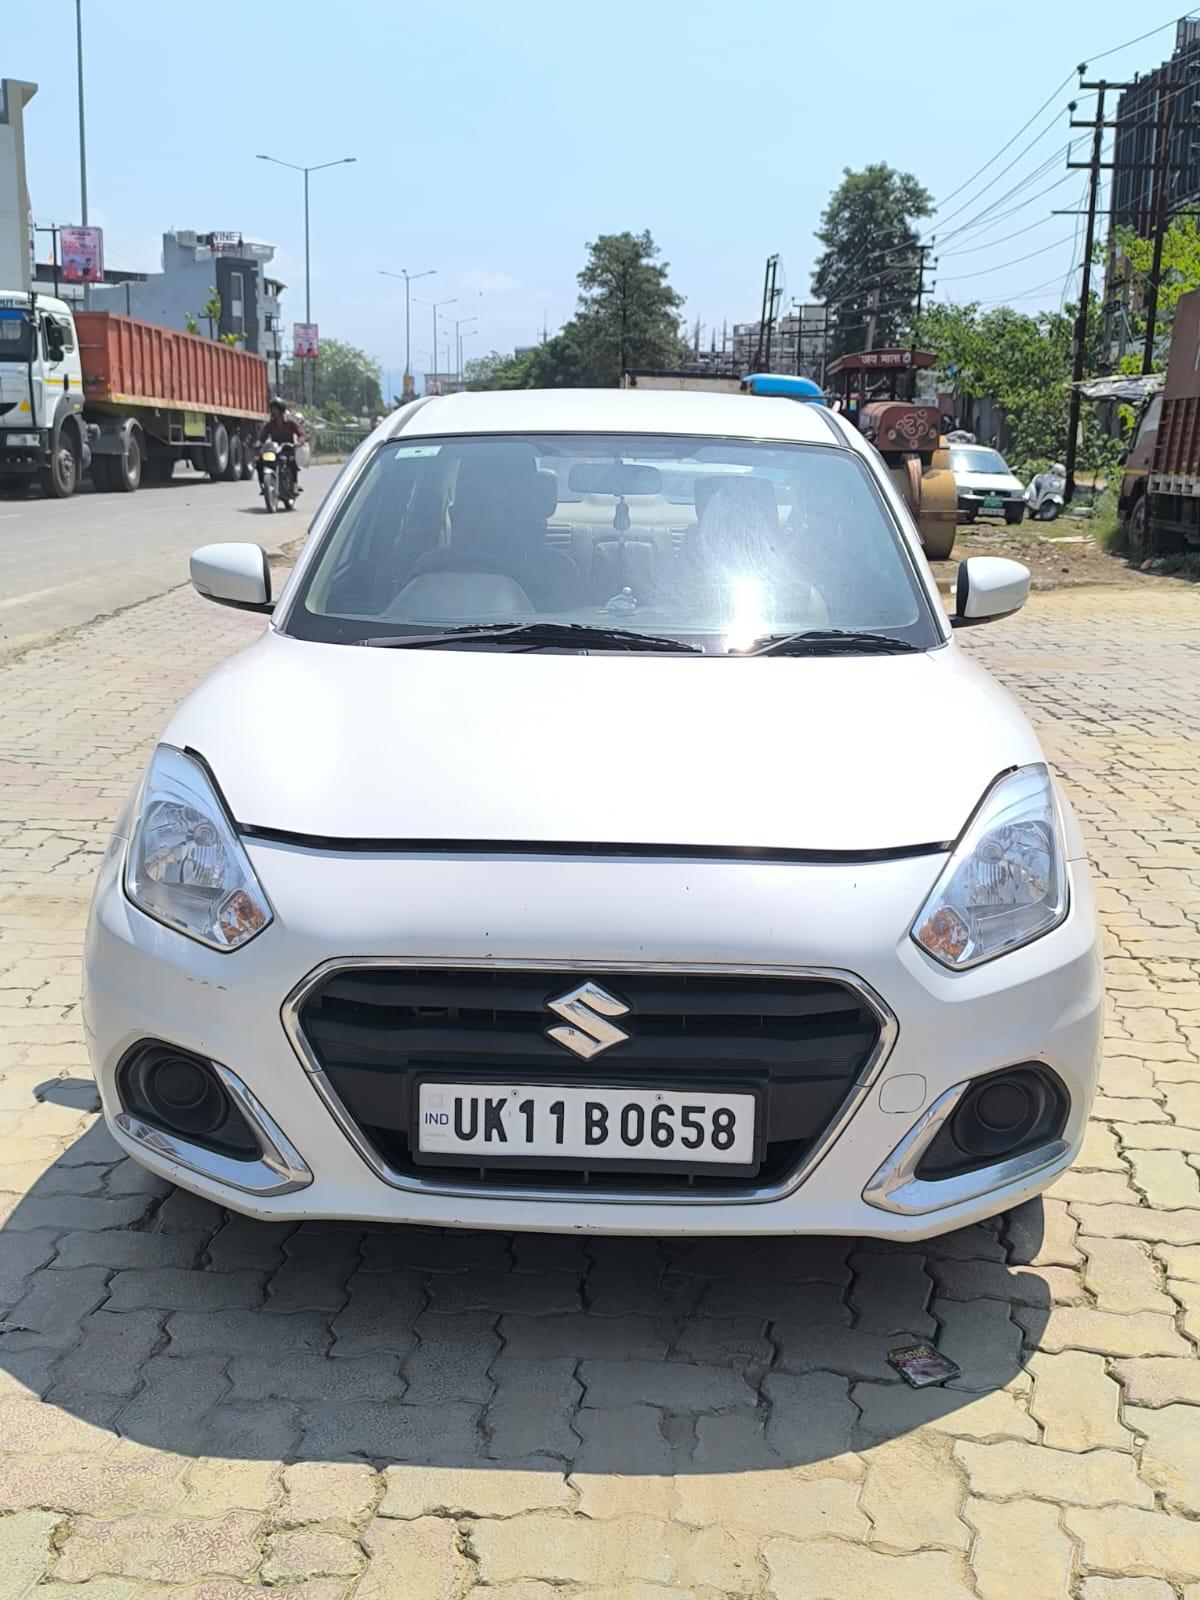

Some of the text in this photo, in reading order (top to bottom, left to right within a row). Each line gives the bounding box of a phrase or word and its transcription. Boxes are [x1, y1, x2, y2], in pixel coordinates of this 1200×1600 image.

[859, 355, 878, 364] जय
[880, 354, 901, 364] माता
[425, 1112, 449, 1125] IND
